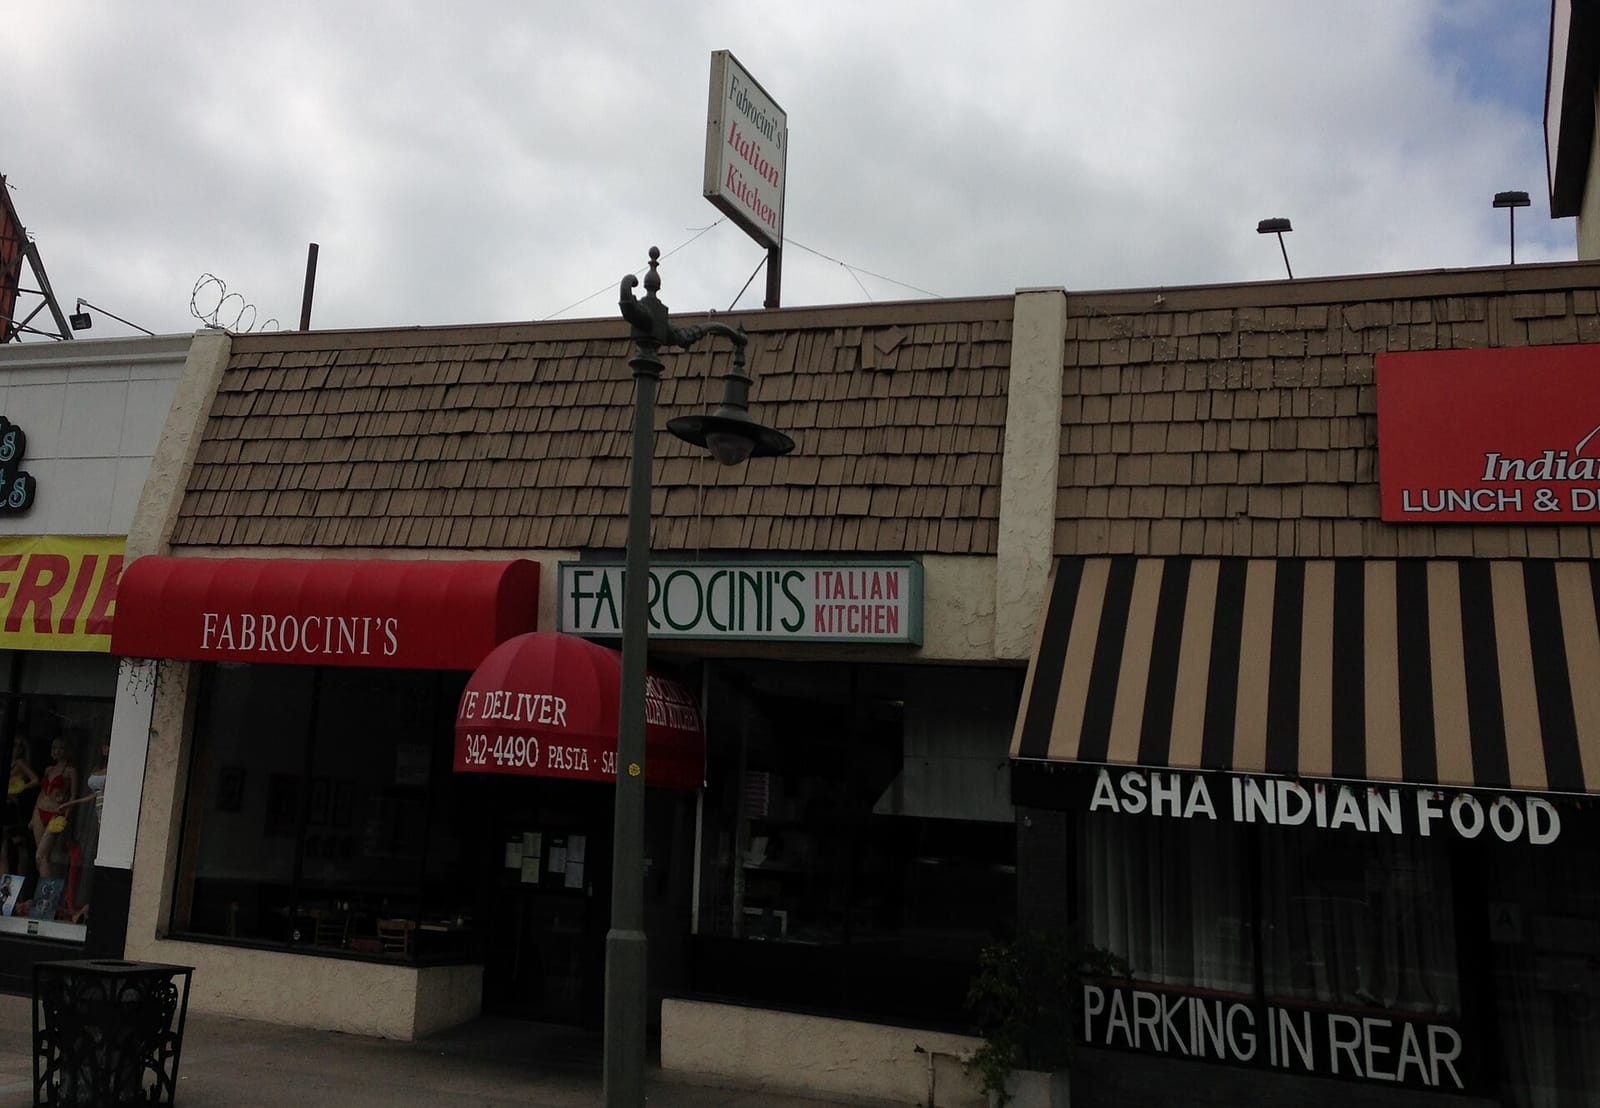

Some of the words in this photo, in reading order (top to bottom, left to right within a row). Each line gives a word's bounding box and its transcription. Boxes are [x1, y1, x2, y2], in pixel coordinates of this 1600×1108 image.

[729, 74, 783, 150] Fabrocini's
[727, 120, 780, 188] Italian
[725, 163, 777, 229] Kitchen
[1481, 450, 1600, 481] India
[1402, 488, 1522, 512] LUNCH
[1533, 488, 1561, 512] &
[570, 568, 806, 633] FAROCINI'S
[814, 571, 899, 600] ITALIAN
[200, 612, 399, 656] FABROCINI'S
[814, 604, 899, 634] KITCHEN
[481, 690, 568, 727] DELIVER
[464, 734, 540, 768] 342-4490
[547, 745, 589, 772] PASTA
[1089, 767, 1218, 820] ASHA
[1232, 775, 1403, 835] INDIAN
[1417, 789, 1562, 845] FOOD
[1083, 984, 1257, 1062] PARKING
[1268, 1006, 1315, 1071] IN
[1328, 1013, 1465, 1090] REAR
